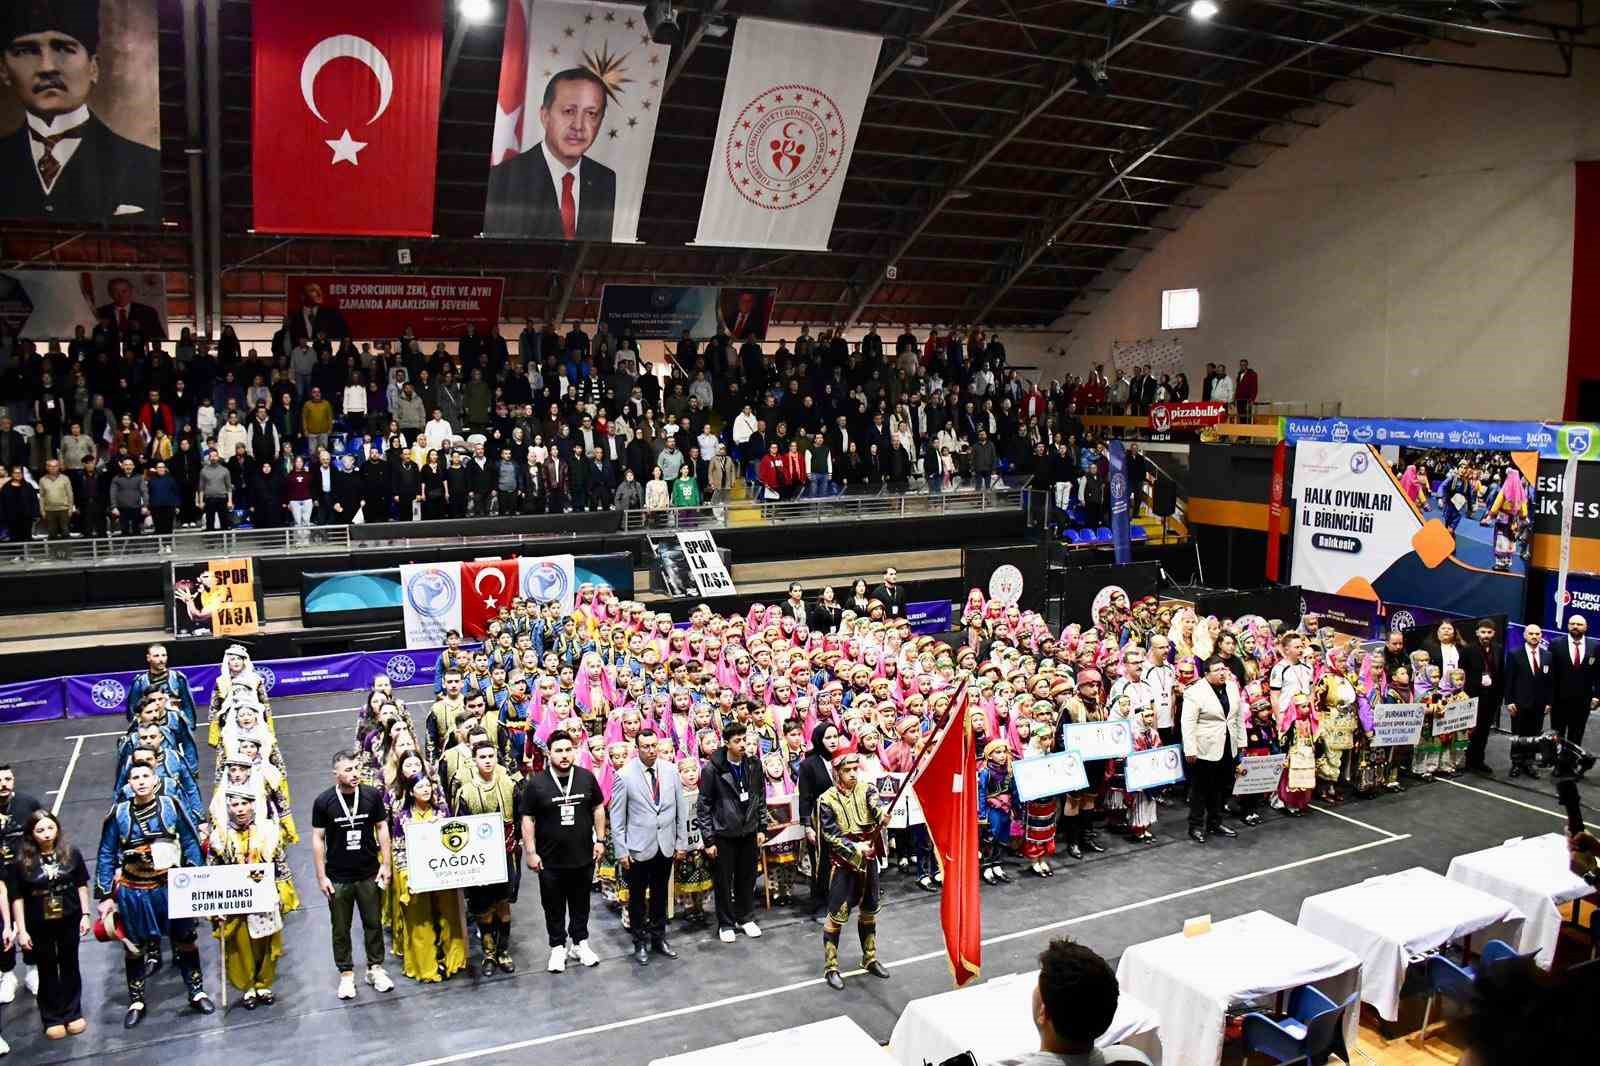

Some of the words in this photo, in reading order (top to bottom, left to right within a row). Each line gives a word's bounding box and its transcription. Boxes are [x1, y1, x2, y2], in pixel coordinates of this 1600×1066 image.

[329, 284, 347, 295] BEN
[457, 286, 470, 297] VE
[470, 286, 492, 298] AYNI
[339, 299, 384, 310] ZAMANDA
[1171, 405, 1218, 420] pizzabulls
[1289, 422, 1328, 434] RAMADA
[1413, 430, 1445, 440] Arinna
[1462, 437, 1485, 446] GOLD
[1304, 487, 1332, 506] HALK
[1335, 490, 1392, 512] OYUNLARI
[1302, 506, 1312, 526] İL
[1314, 507, 1374, 534] BİRİNCİLİĞİ
[685, 539, 715, 554] SPOR
[691, 555, 708, 569] LA
[214, 569, 248, 585] SPOR
[217, 606, 253, 626] YAŞA
[226, 888, 253, 899] DANSI
[191, 903, 216, 912] SPOR
